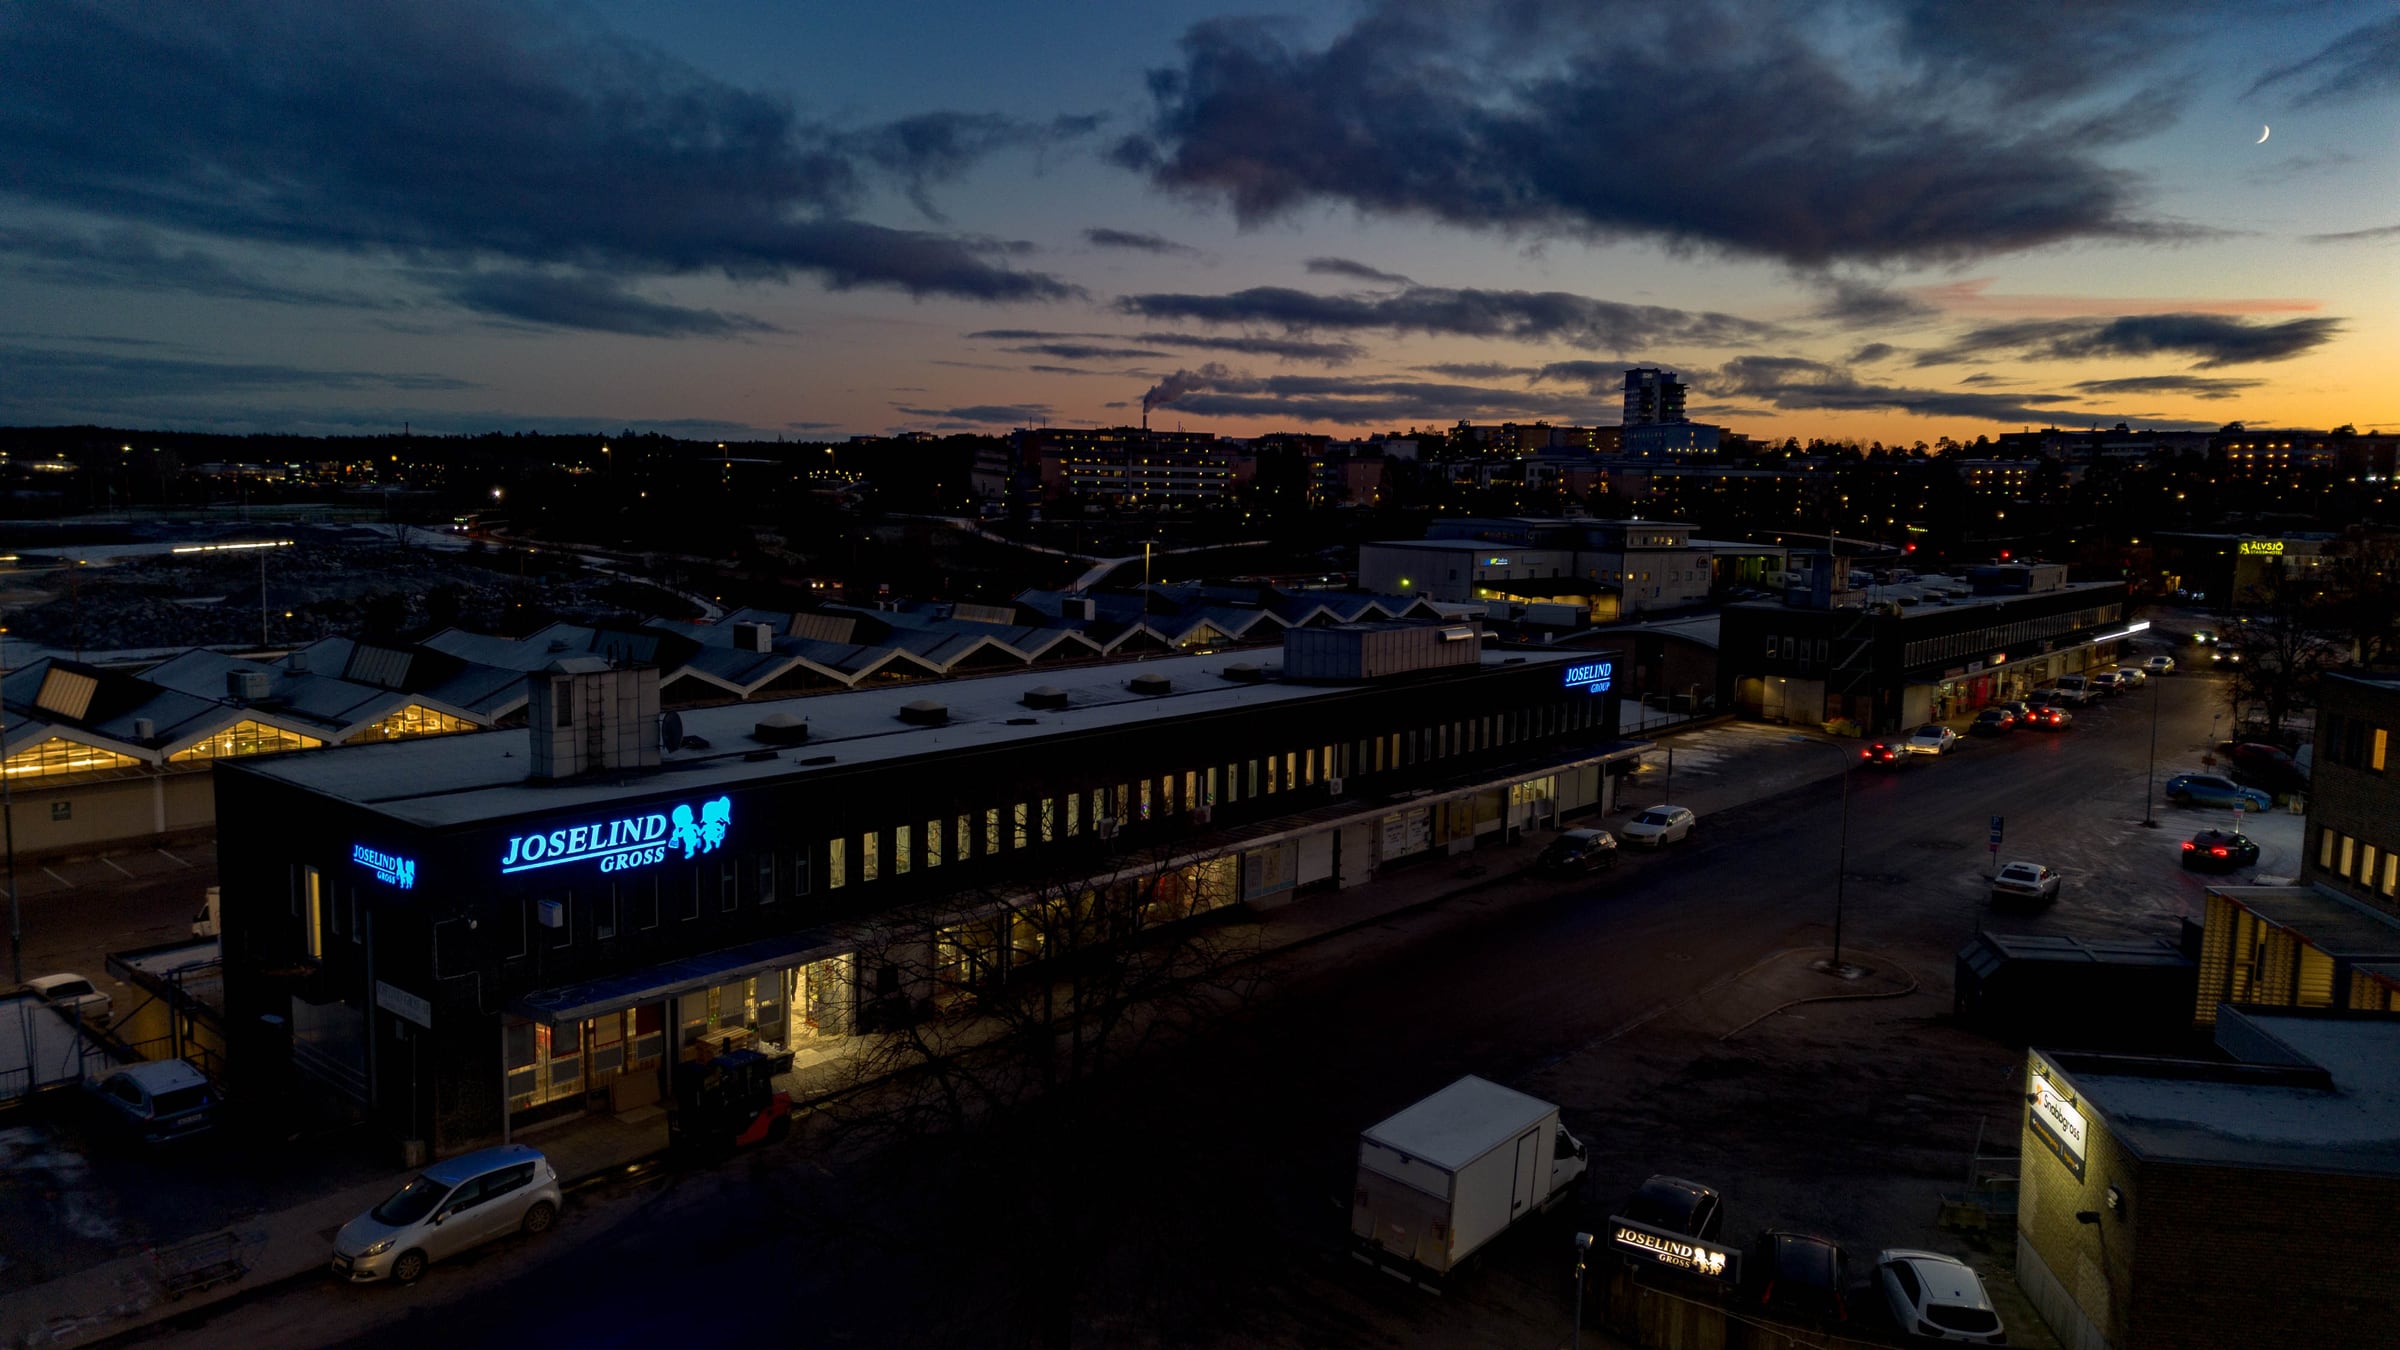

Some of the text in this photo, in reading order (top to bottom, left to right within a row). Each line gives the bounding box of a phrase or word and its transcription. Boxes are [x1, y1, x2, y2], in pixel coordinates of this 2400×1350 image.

[1566, 663, 1612, 683] JOSELIND
[502, 814, 667, 865] JOSELIND
[353, 844, 396, 871] JOSELIND
[600, 846, 665, 872] GROSS
[377, 870, 396, 885] GROSS
[2043, 1094, 2080, 1141] Snabbgross
[1617, 1227, 1693, 1258] JOSELIND
[1658, 1253, 1691, 1269] GROSS
